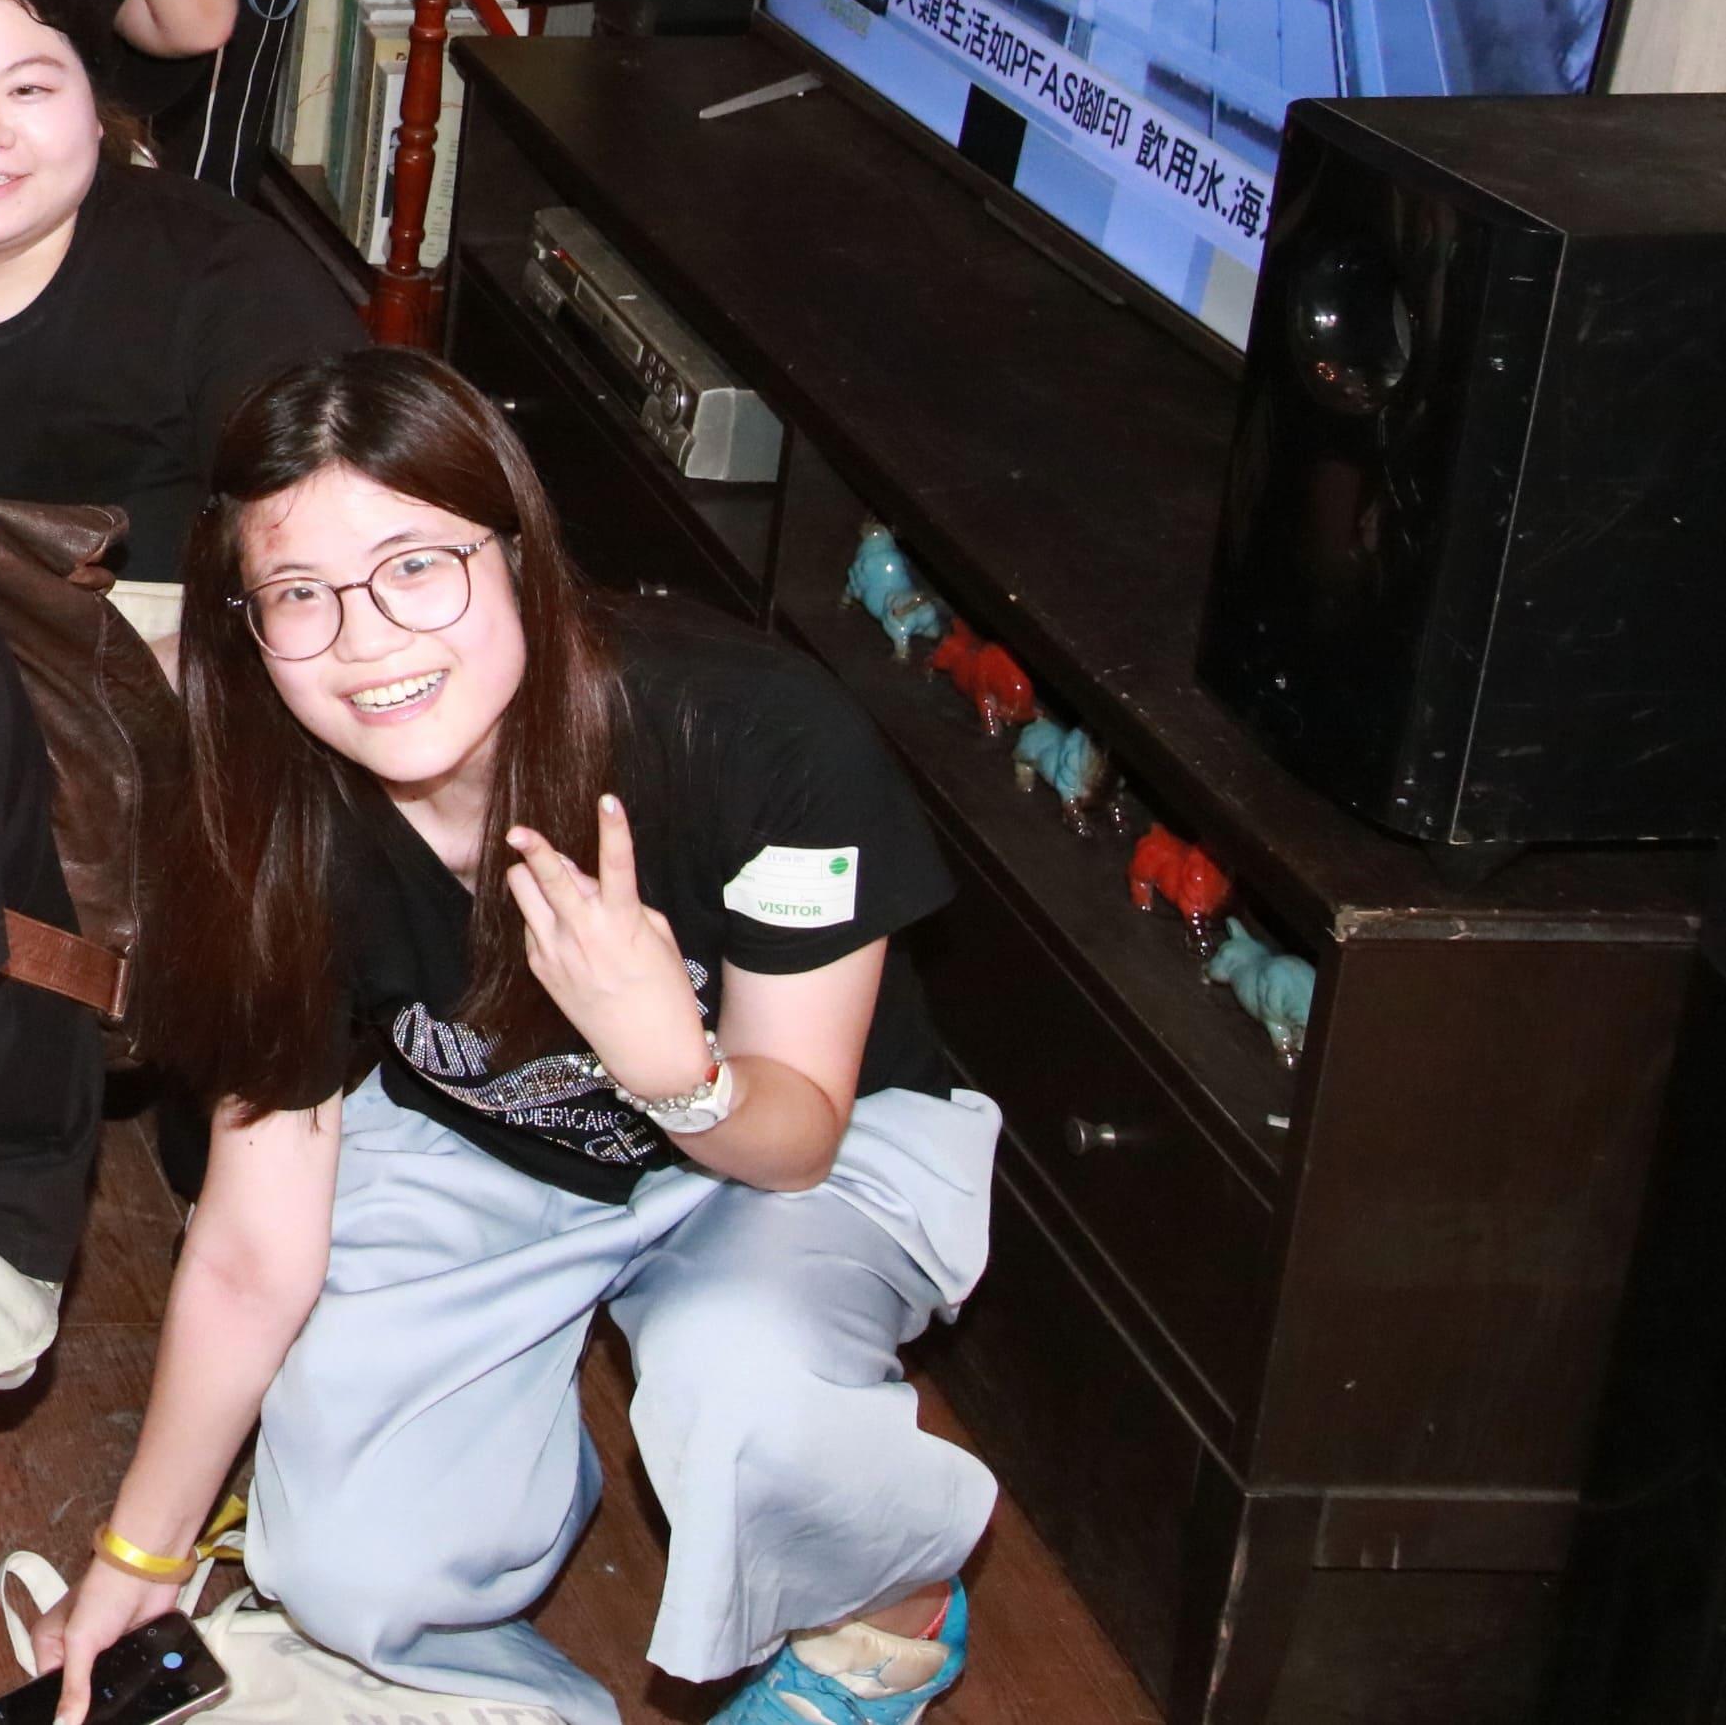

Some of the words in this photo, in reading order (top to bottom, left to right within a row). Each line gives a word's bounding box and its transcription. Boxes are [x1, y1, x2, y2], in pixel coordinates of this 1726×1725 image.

[1135, 118, 1271, 241] 飲用水.海
[757, 899, 823, 917] VISITOR
